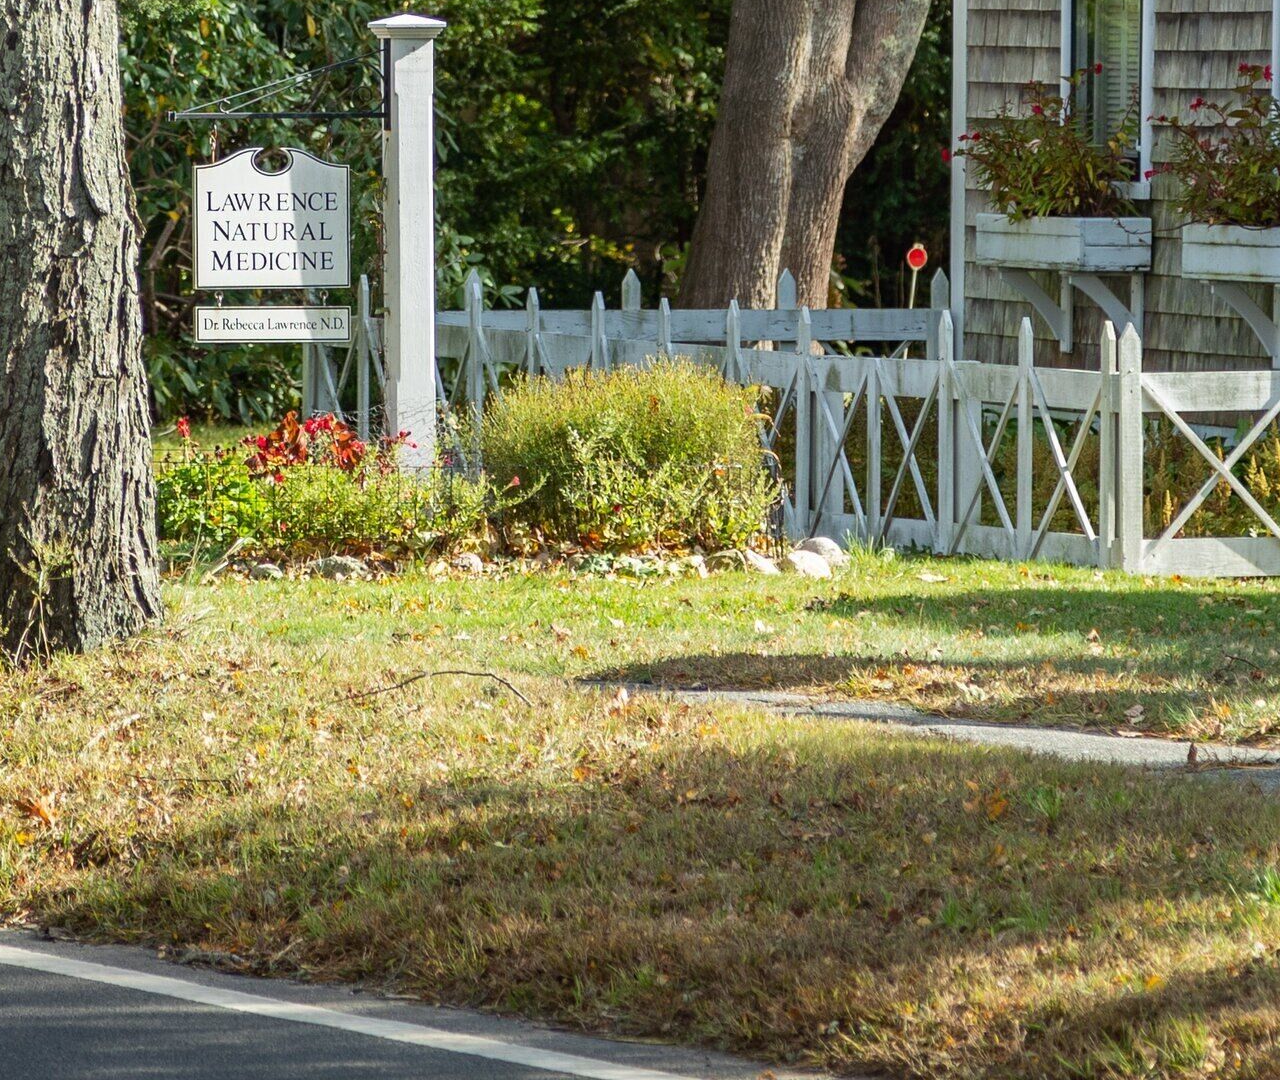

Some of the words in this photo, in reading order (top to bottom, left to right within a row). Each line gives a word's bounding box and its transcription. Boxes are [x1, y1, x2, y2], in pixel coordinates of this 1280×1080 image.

[206, 191, 338, 212] LAWRENCE
[212, 220, 333, 241] NATURAL
[211, 250, 334, 271] MEDICINE
[204, 318, 219, 331] Dr.
[222, 318, 265, 331] Rebecca
[267, 318, 318, 331] Lawrence
[320, 317, 345, 331] N.D.
